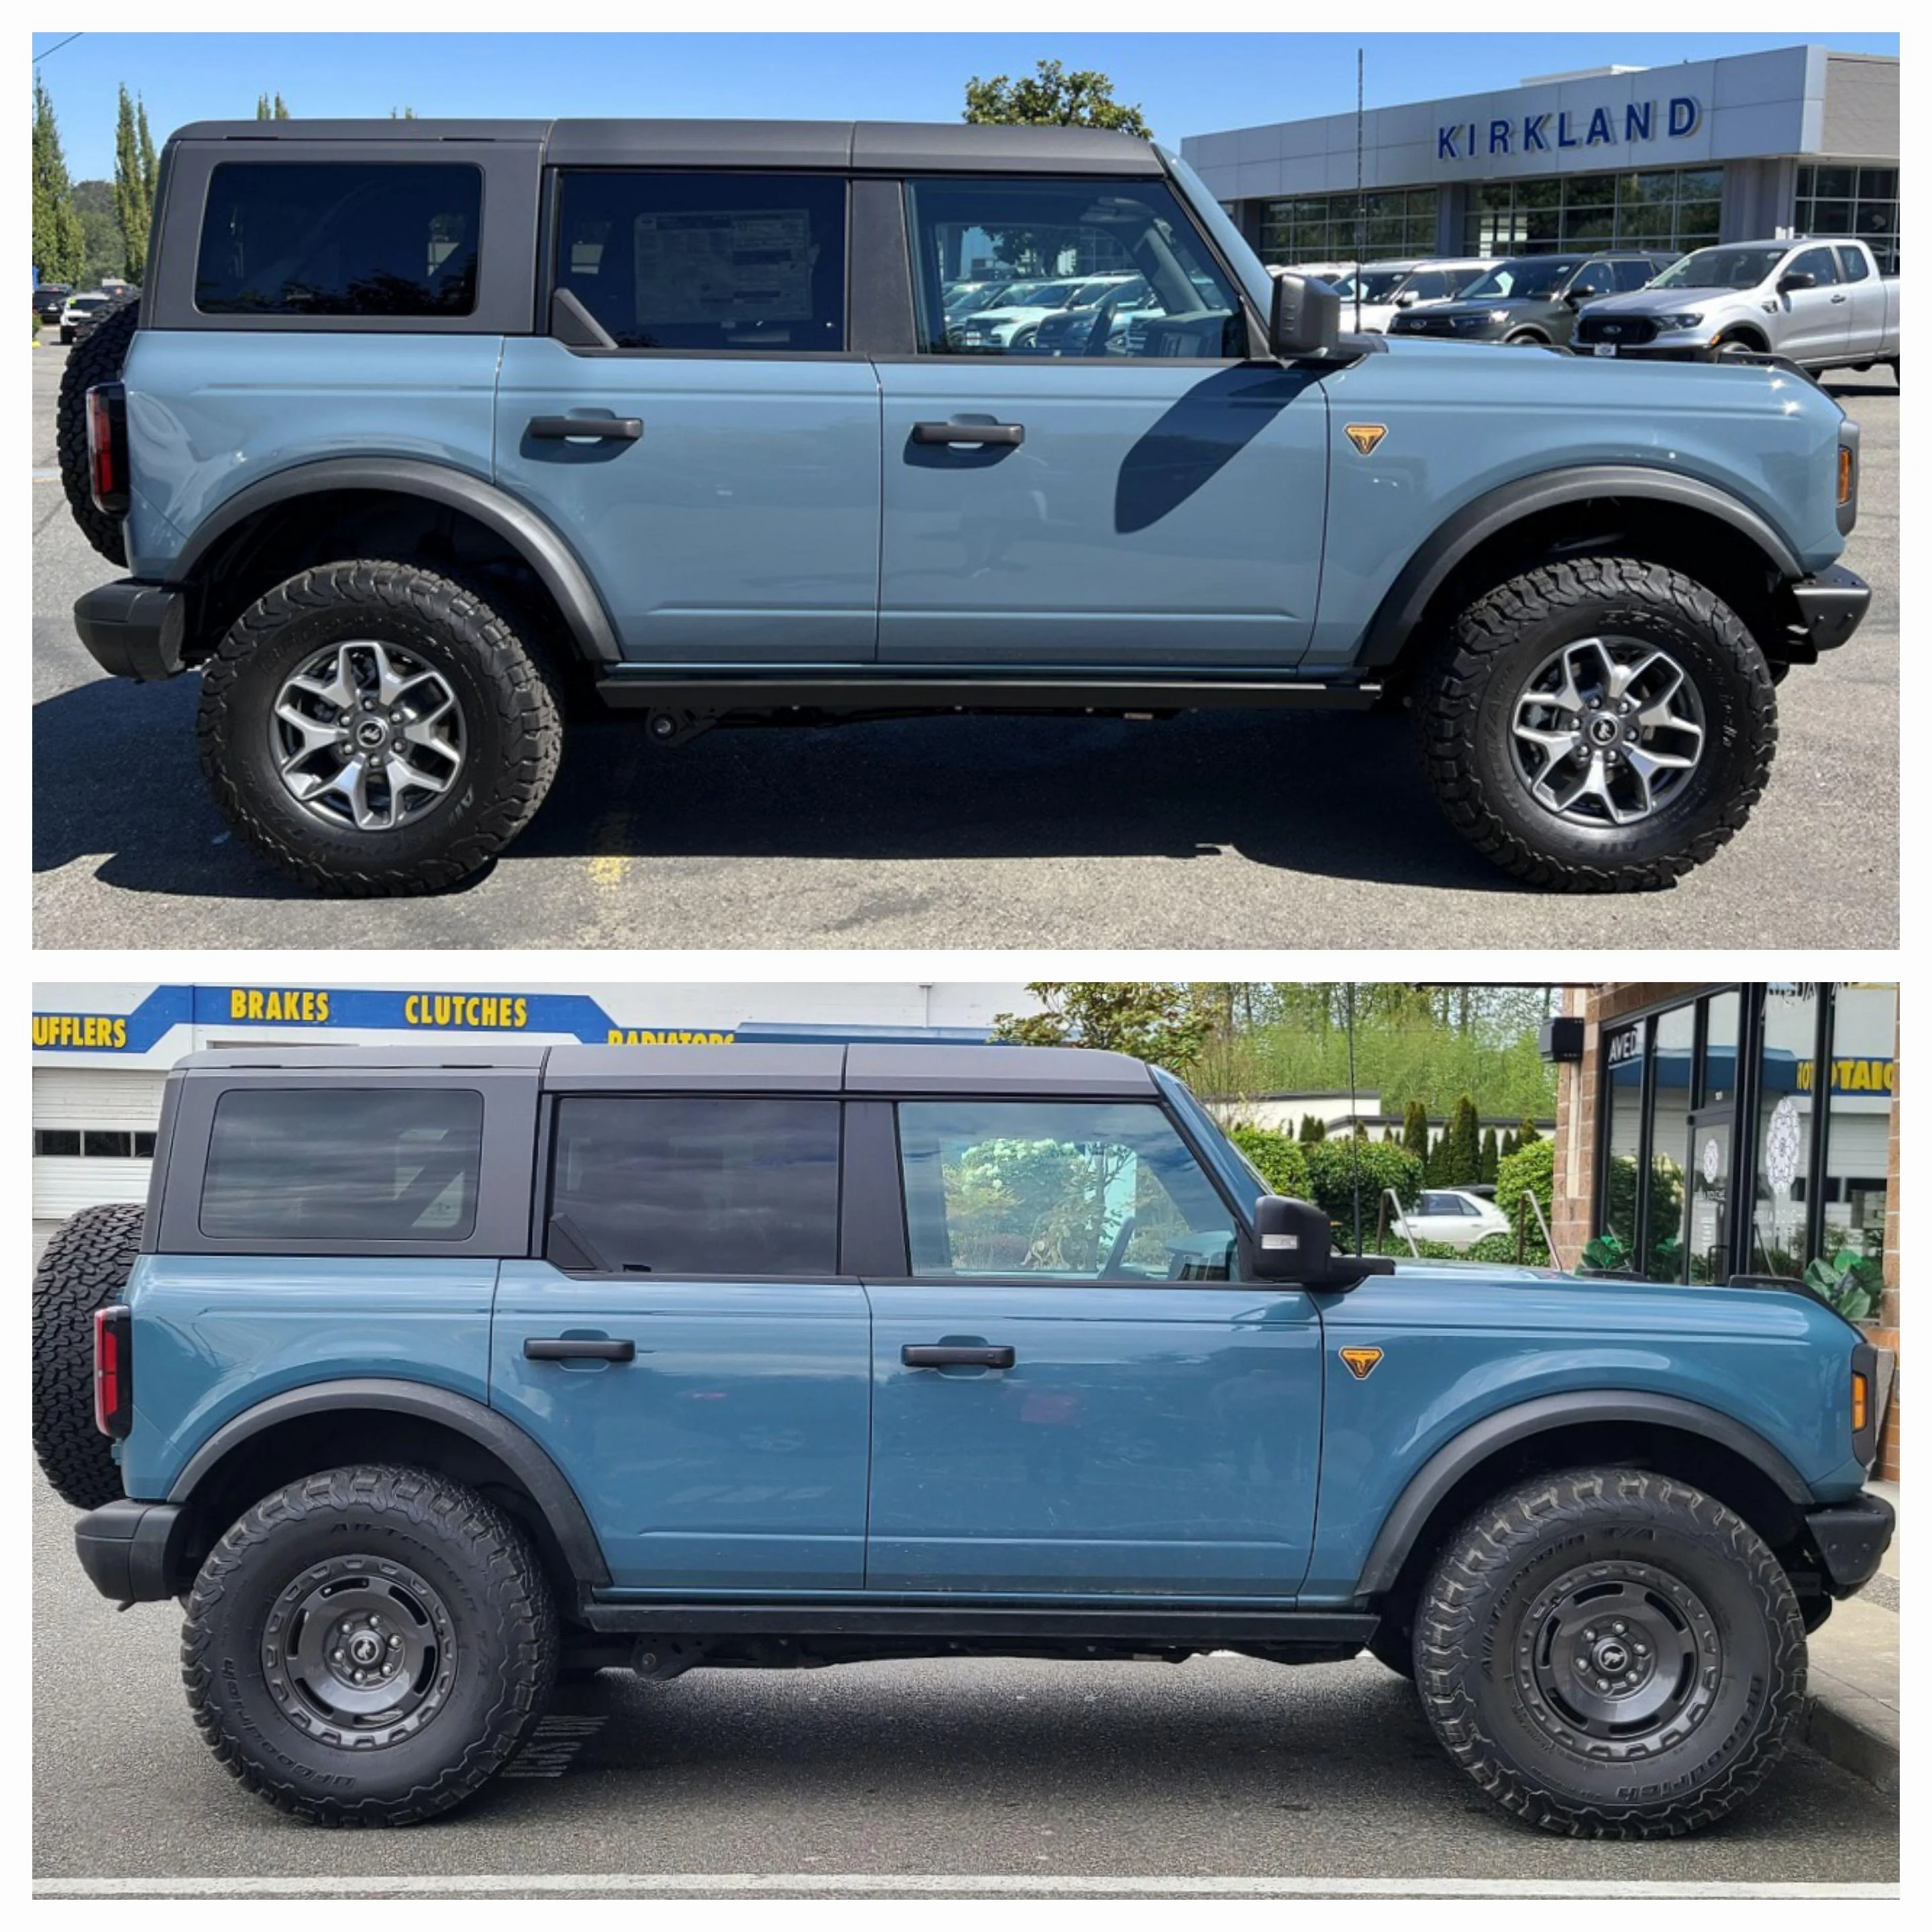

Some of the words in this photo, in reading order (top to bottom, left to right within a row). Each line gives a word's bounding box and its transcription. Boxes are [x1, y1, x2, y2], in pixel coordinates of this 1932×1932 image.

[1437, 97, 1697, 160] KIRKLAND
[231, 989, 329, 1022] BRAKES
[404, 995, 528, 1028] CLUTCHES
[32, 1016, 126, 1049] UFFLERS
